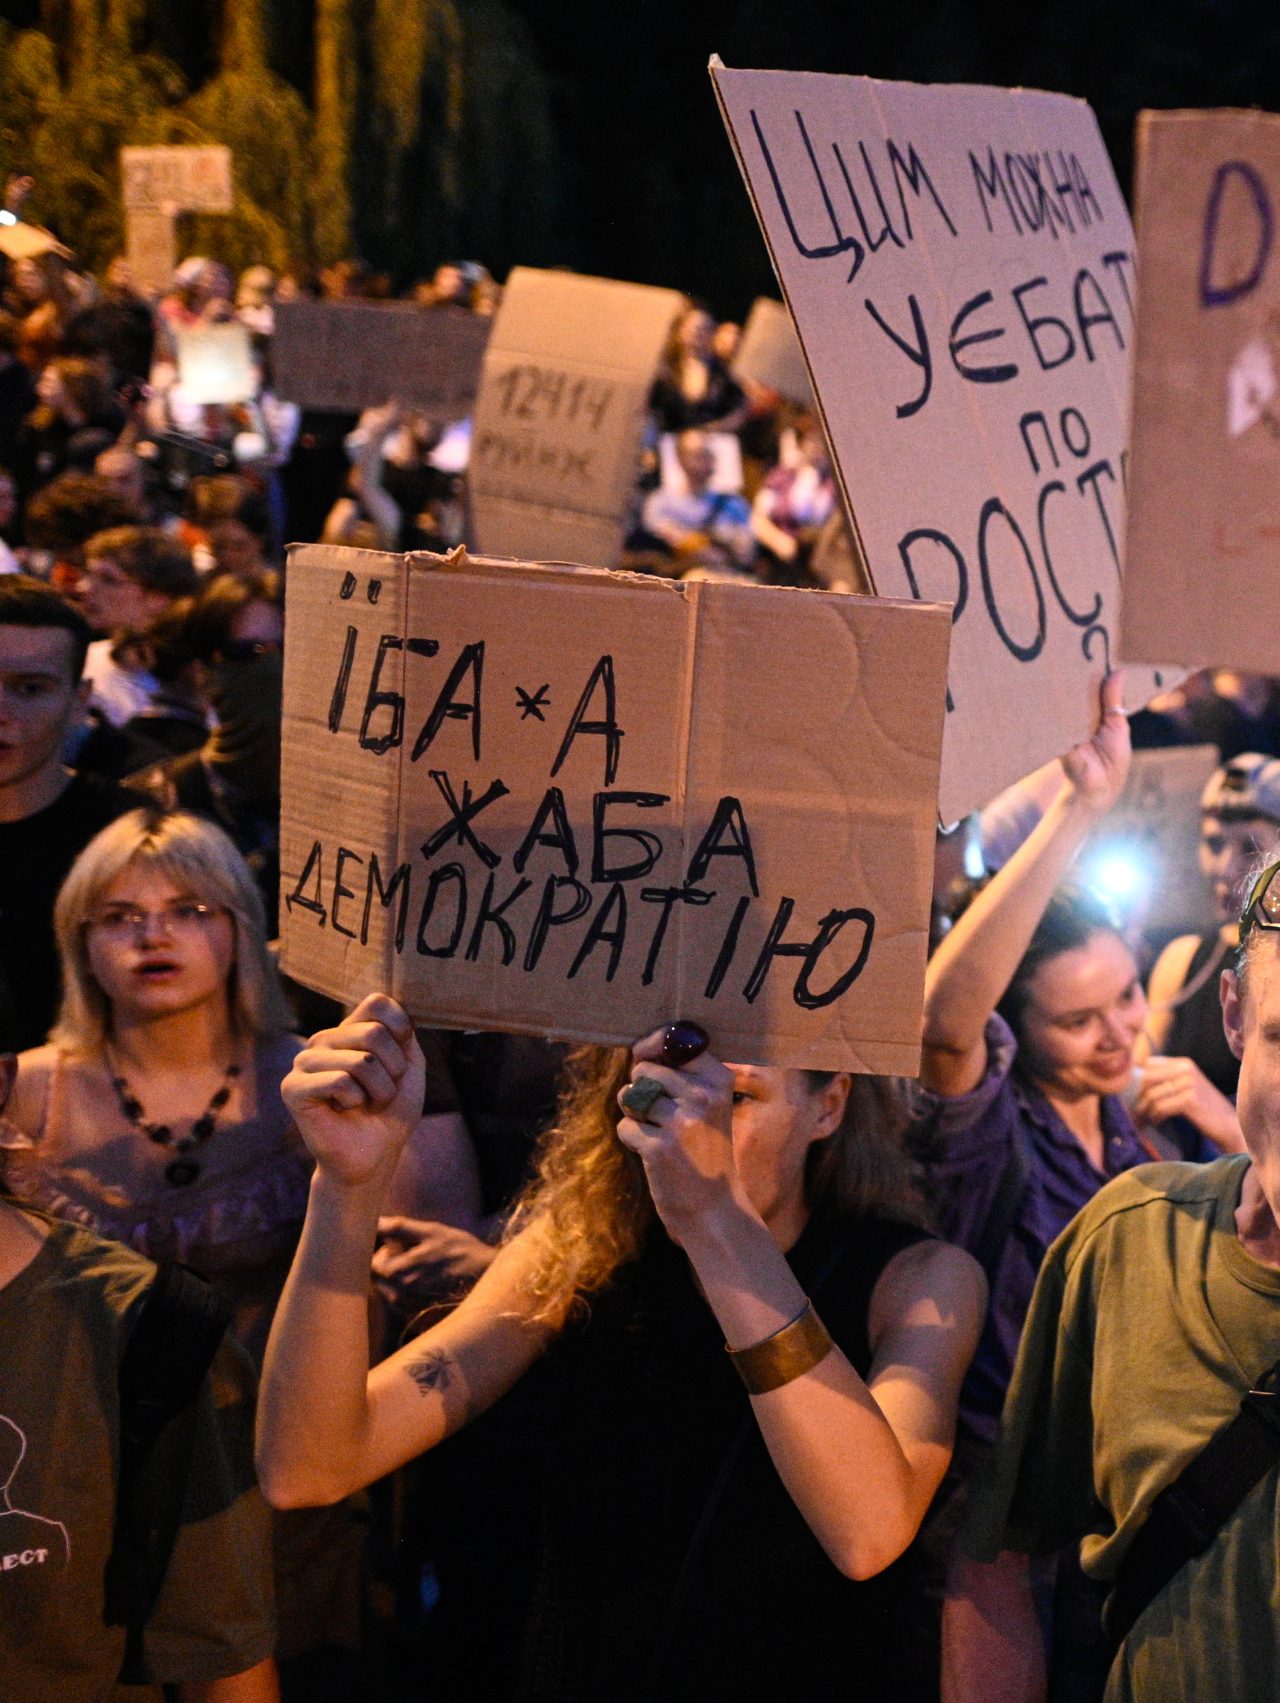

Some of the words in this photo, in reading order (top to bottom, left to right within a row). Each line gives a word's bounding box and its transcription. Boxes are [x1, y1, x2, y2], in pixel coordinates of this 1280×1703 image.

[749, 109, 958, 283] ЦИМ
[968, 144, 1104, 240] МОЖНА
[1019, 406, 1092, 474] ПО
[897, 452, 1128, 712] РОСТ
[420, 770, 760, 898] ЖАБА
[285, 841, 876, 1010] ДЕМОКРАТІЮ
[0, 1548, 49, 1571] ECT
